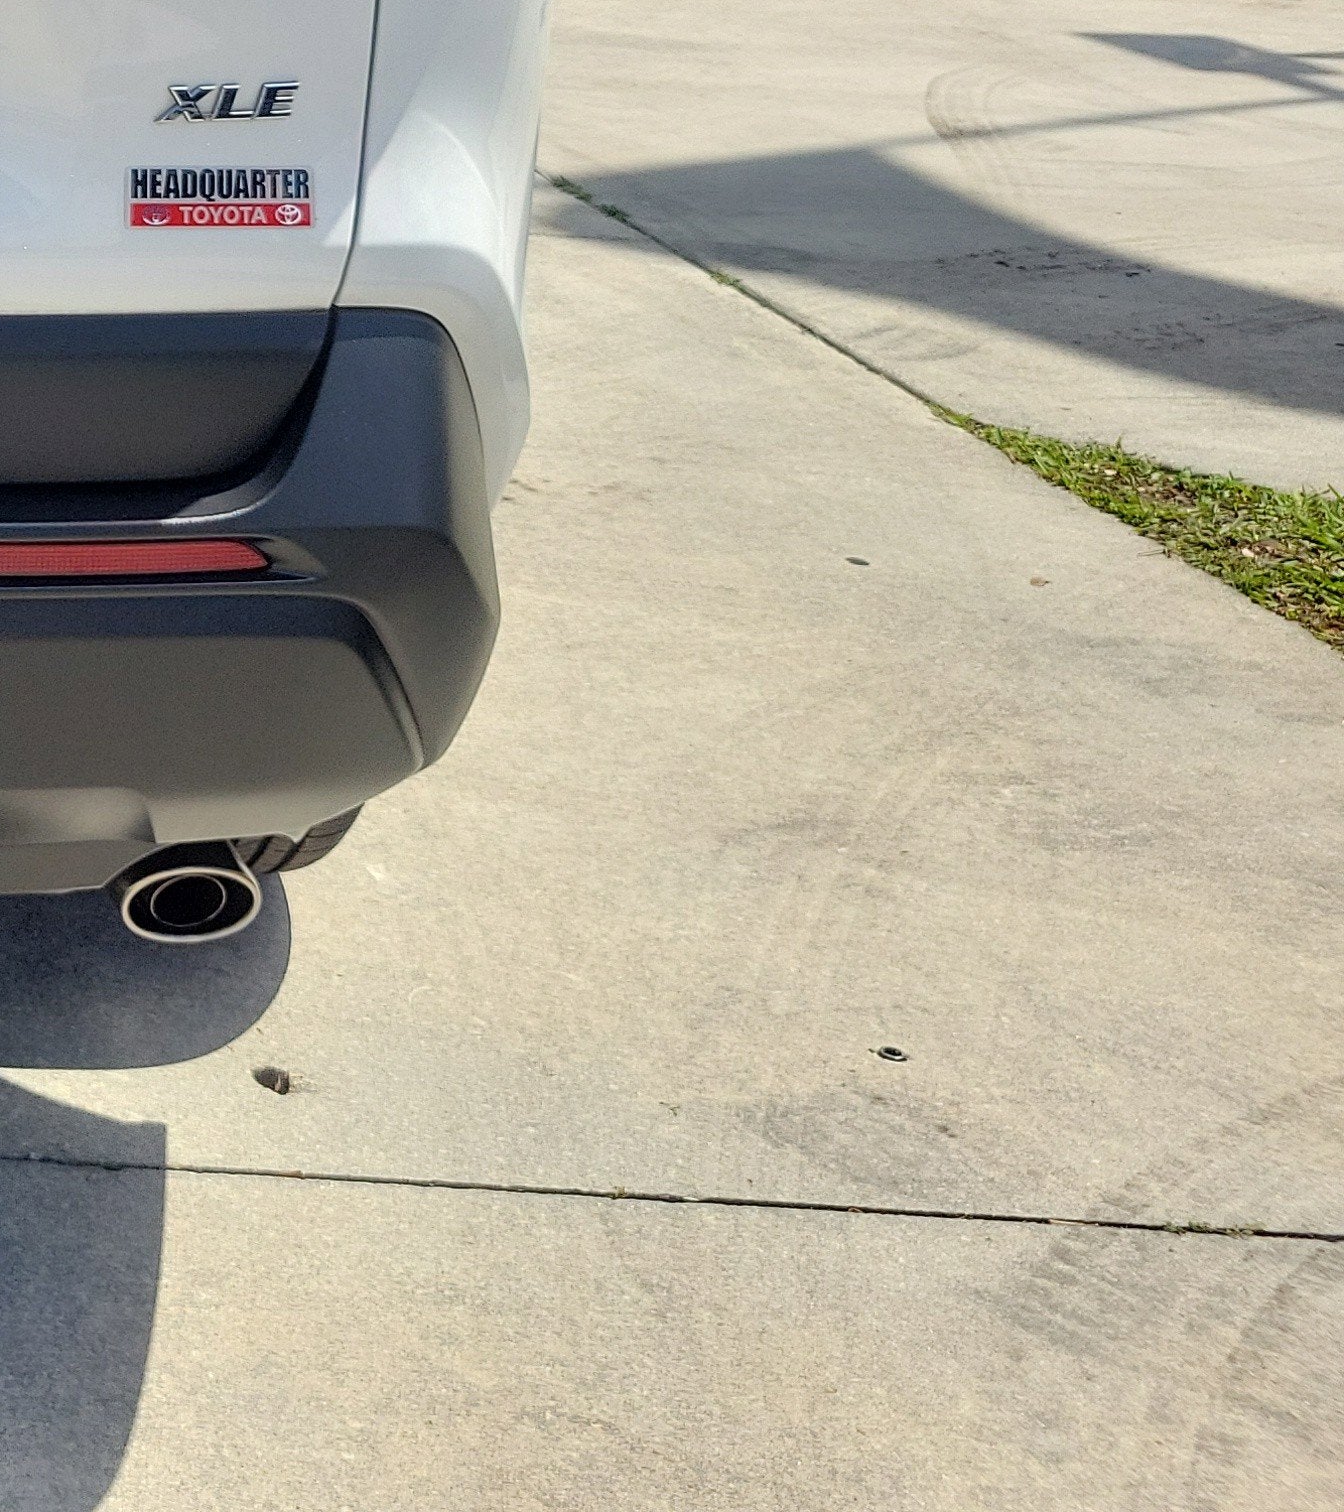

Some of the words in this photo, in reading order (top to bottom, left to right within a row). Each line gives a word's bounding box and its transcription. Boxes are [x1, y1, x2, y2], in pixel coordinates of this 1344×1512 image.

[153, 80, 300, 122] XLE
[130, 168, 310, 202] HEADQUARTER
[179, 206, 268, 225] TOYOTA
